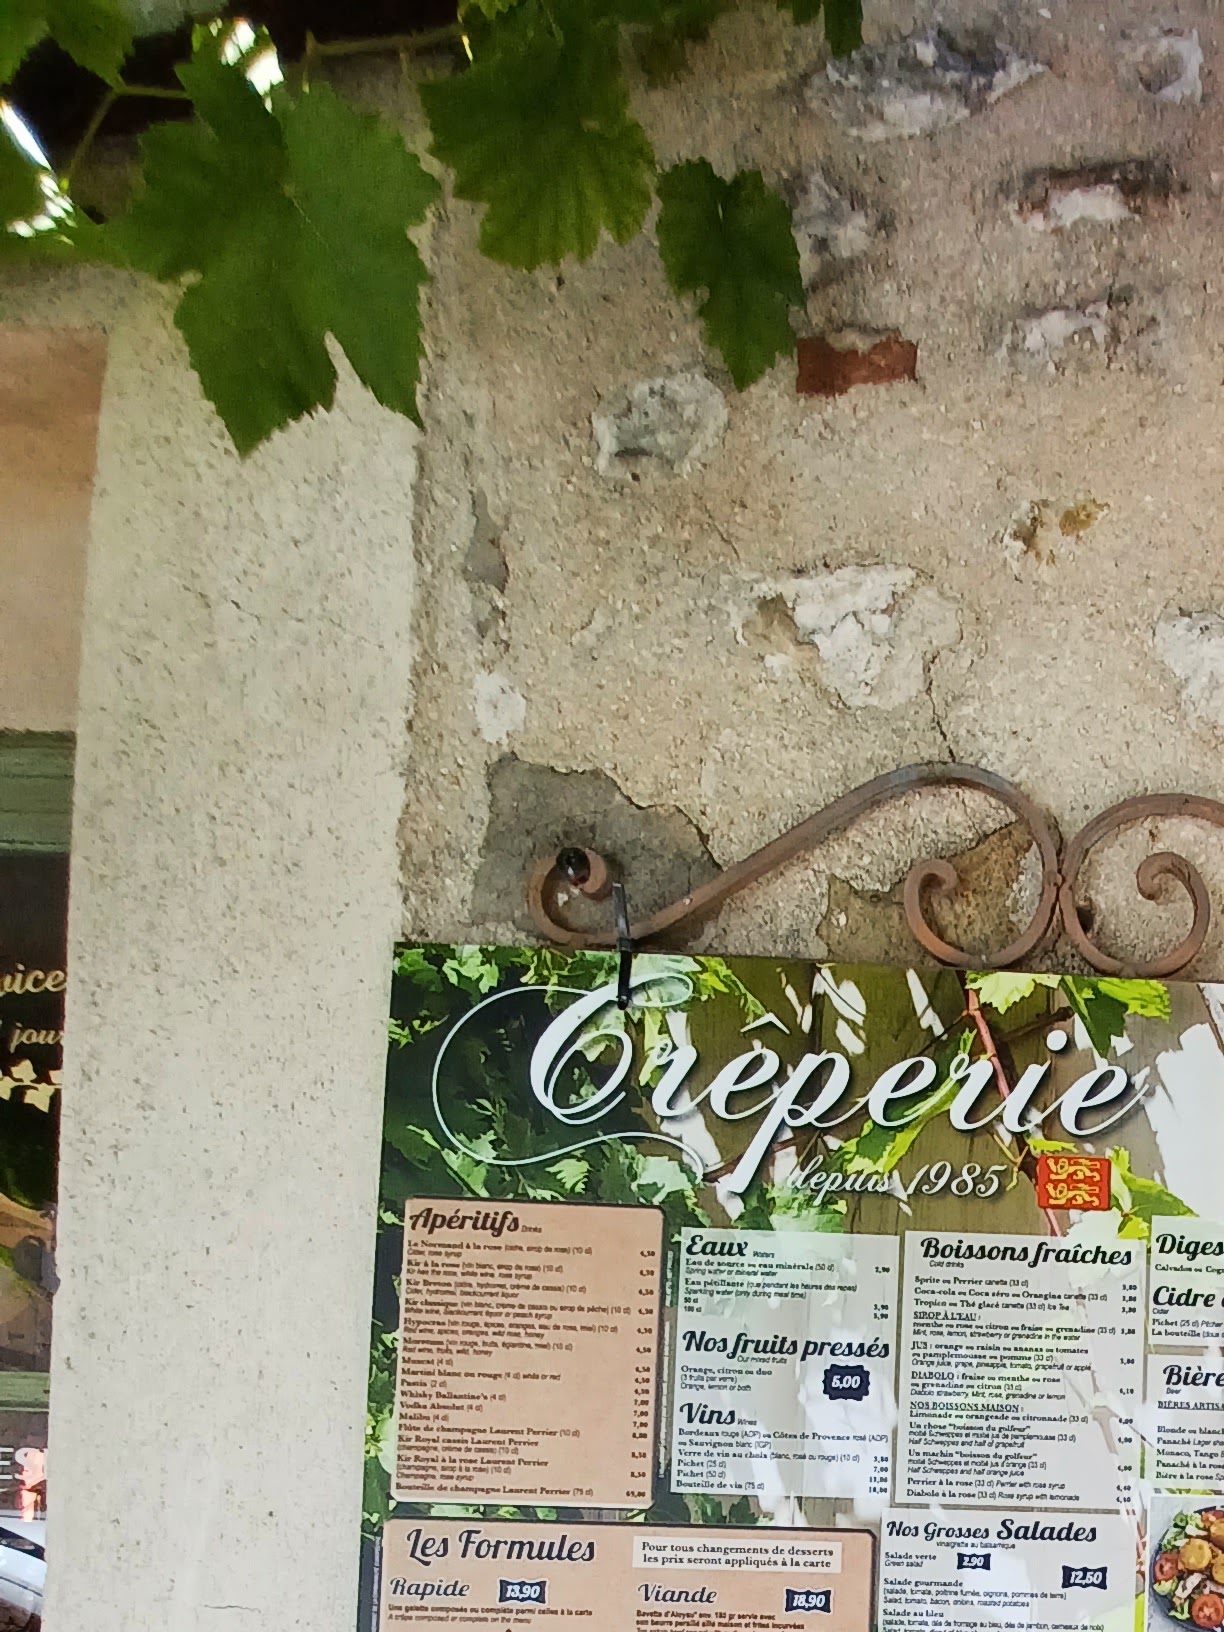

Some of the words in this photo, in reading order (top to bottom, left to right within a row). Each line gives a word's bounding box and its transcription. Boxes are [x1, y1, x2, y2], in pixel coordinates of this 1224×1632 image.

[433, 973, 1145, 1193] Crêperie
[787, 1162, 895, 1195] depuis
[904, 1161, 1007, 1198] 1985
[409, 1208, 520, 1237] Apéritifs
[686, 1235, 748, 1257] Eaux
[921, 1237, 1029, 1261] Boissons
[1028, 1241, 1131, 1267] fraîches
[1153, 1286, 1215, 1307] Cidre
[683, 1331, 727, 1351] Nos
[727, 1333, 798, 1359] fruits
[801, 1337, 889, 1361] pressés
[680, 1402, 735, 1425] Vins
[887, 1521, 919, 1537] Nos
[924, 1522, 989, 1541] Grosses
[996, 1519, 1096, 1542] Salades
[407, 1529, 449, 1566] Les
[459, 1530, 595, 1561] Formules
[642, 1542, 667, 1551] Pour
[671, 1544, 694, 1552] tous
[697, 1543, 769, 1555] changements
[772, 1546, 785, 1554] de
[788, 1546, 833, 1556] desserts
[644, 1554, 658, 1563] les
[662, 1555, 684, 1566] prix
[687, 1556, 722, 1565] seront
[725, 1556, 778, 1568] appliqués
[781, 1558, 787, 1567] à
[790, 1558, 800, 1567] la
[803, 1560, 831, 1568] carte
[390, 1577, 470, 1600] Rapide
[506, 1585, 540, 1599] 13,90
[638, 1584, 717, 1603] Viande
[793, 1594, 825, 1608] 18,90
